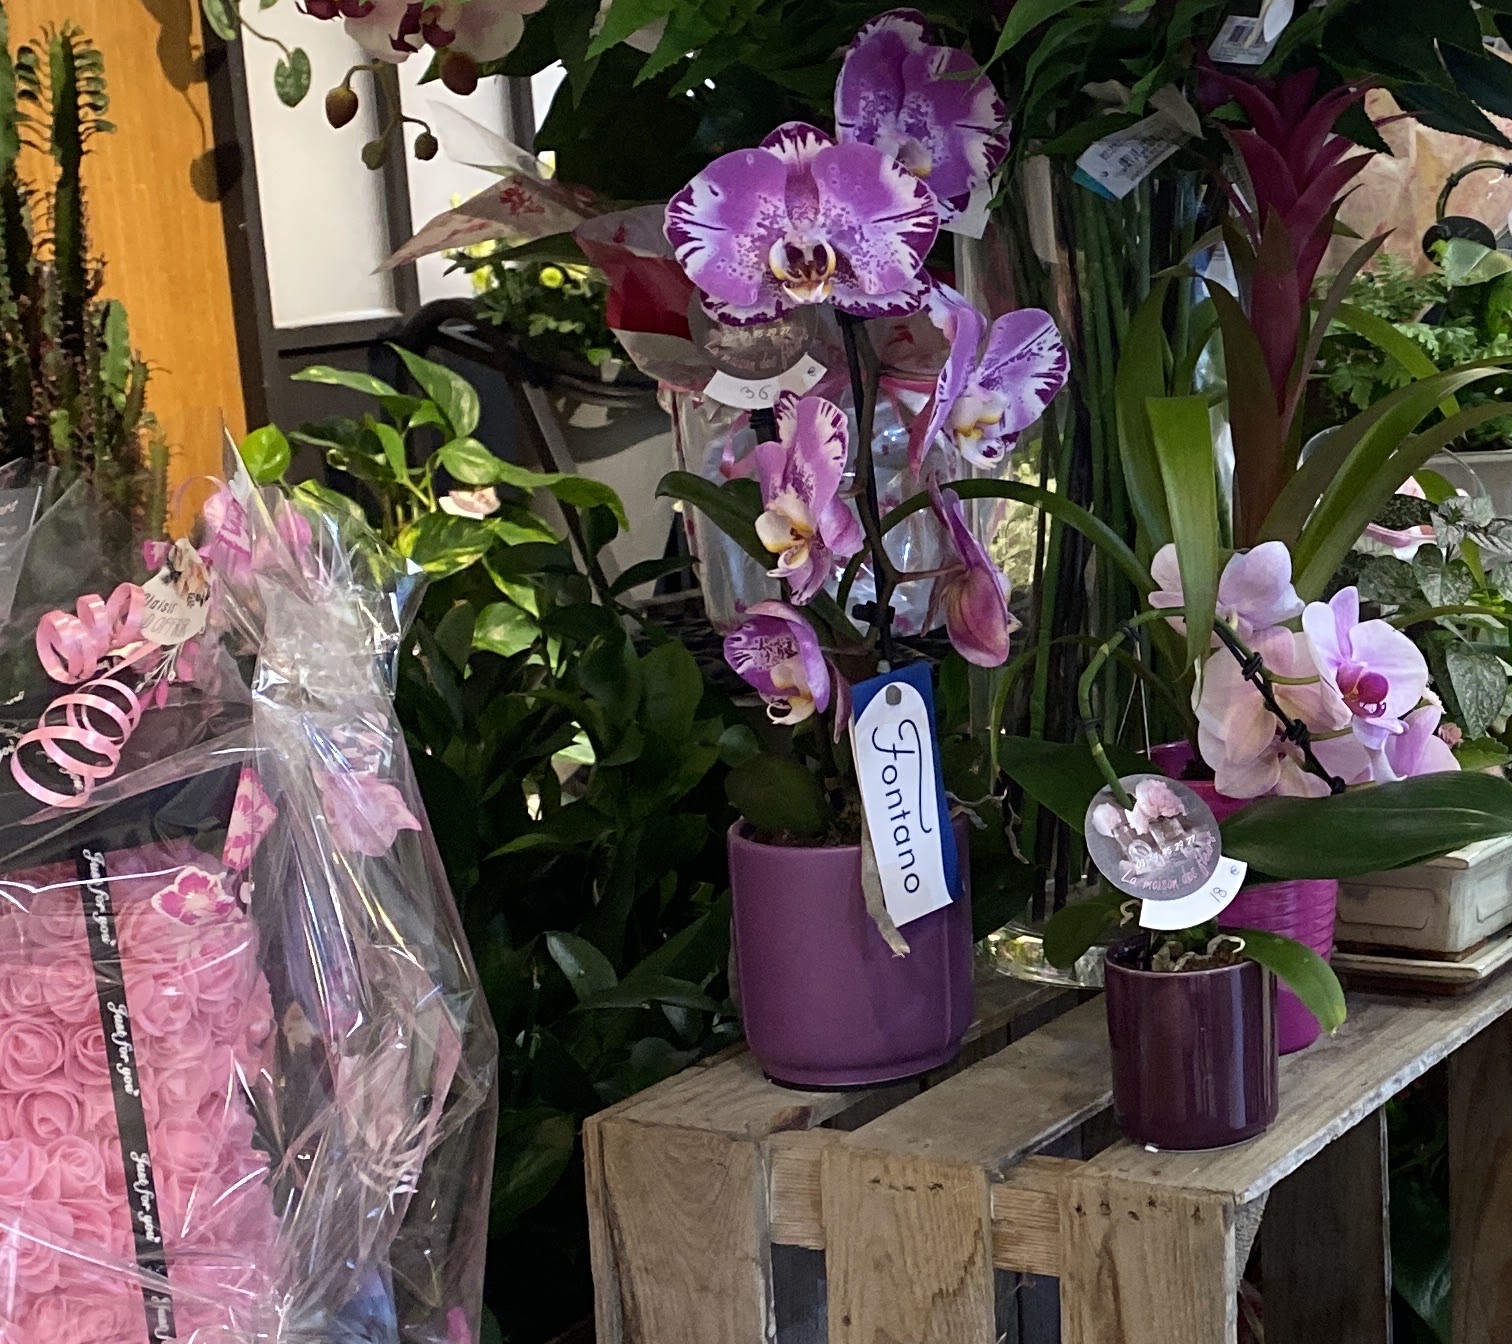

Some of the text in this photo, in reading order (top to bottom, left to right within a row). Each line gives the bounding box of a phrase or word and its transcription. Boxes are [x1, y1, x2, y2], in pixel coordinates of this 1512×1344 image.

[740, 385, 772, 400] 36
[1186, 834, 1196, 846] 27
[1121, 869, 1137, 885] La
[1143, 878, 1179, 891] maison
[1182, 864, 1198, 884] des
[1209, 887, 1228, 903] 18
[107, 1002, 134, 1095] Just for you
[130, 1151, 155, 1242] Just for you
